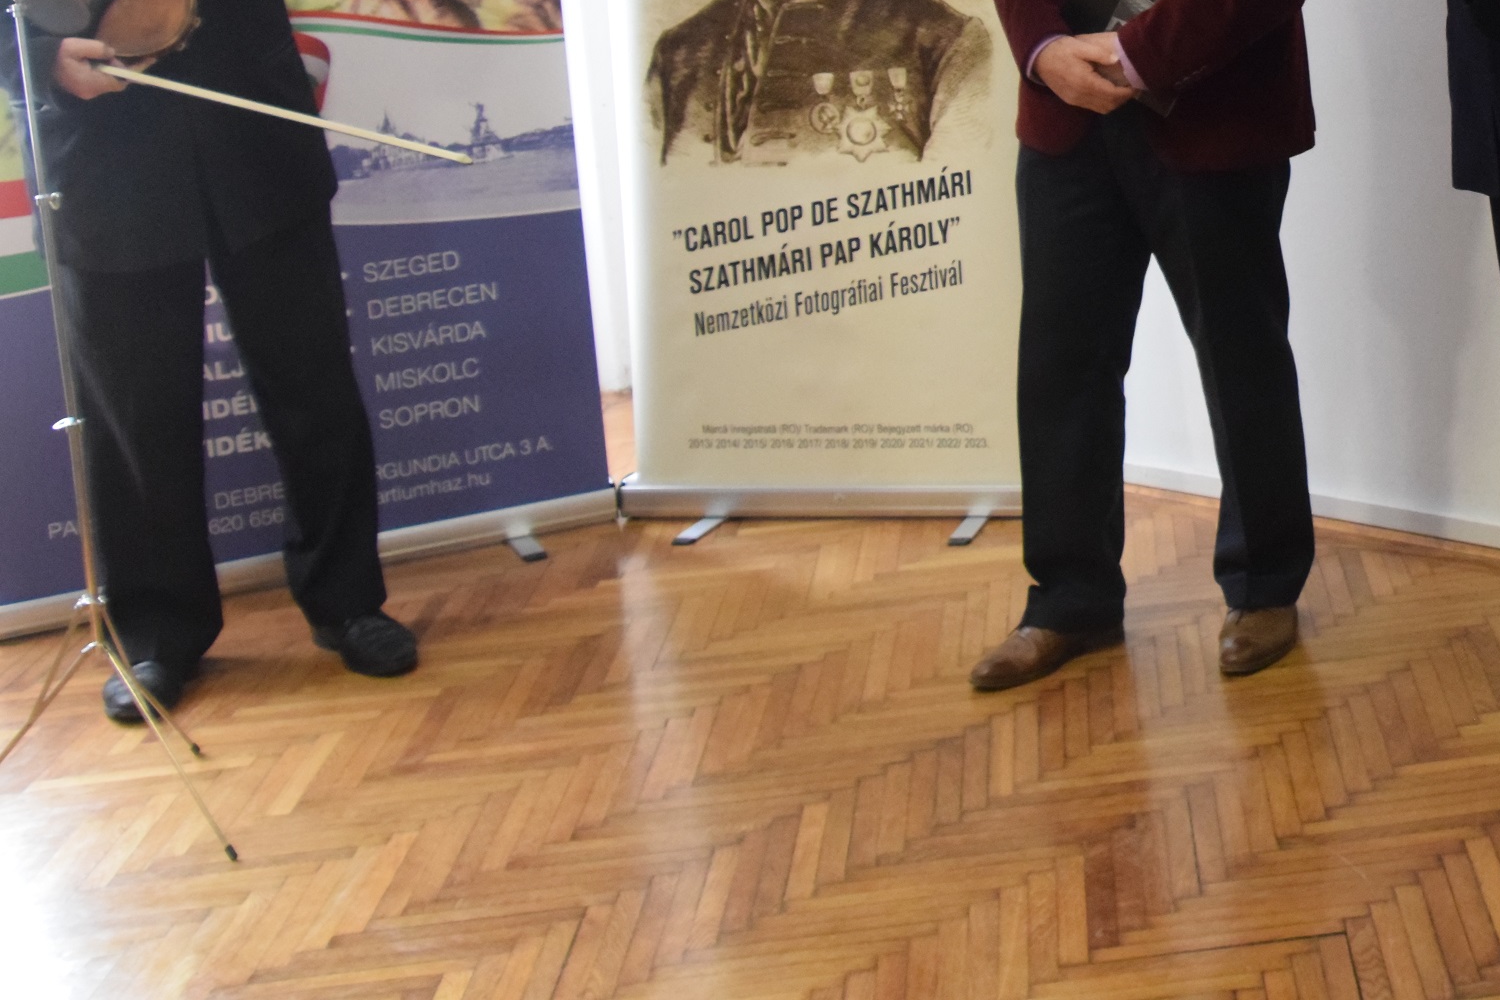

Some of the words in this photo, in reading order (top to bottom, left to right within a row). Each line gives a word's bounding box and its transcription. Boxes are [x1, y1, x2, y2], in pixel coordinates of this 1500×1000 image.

[761, 204, 803, 237] POP
[811, 197, 839, 226] DE
[846, 166, 972, 219] SZATHMÁRI
[363, 251, 460, 283] SZEGED
[689, 243, 813, 294] SZATHMÁRI
[820, 237, 861, 268] PAP
[367, 282, 498, 320] DEBRECEN
[694, 295, 788, 337] Nemzetközi
[794, 275, 883, 317] Fotográfiai
[890, 259, 963, 298] Fesztivál
[371, 321, 487, 356] KISVÁRDA
[375, 358, 480, 393] MISKOLC
[379, 395, 480, 429] SOPRON
[804, 423, 848, 434] Trademark
[214, 482, 286, 509] DEBRE
[376, 452, 461, 480] RGUNDIA
[465, 443, 516, 465] UTCA
[519, 439, 532, 456] 3
[377, 471, 492, 505] artiumhaz.hu
